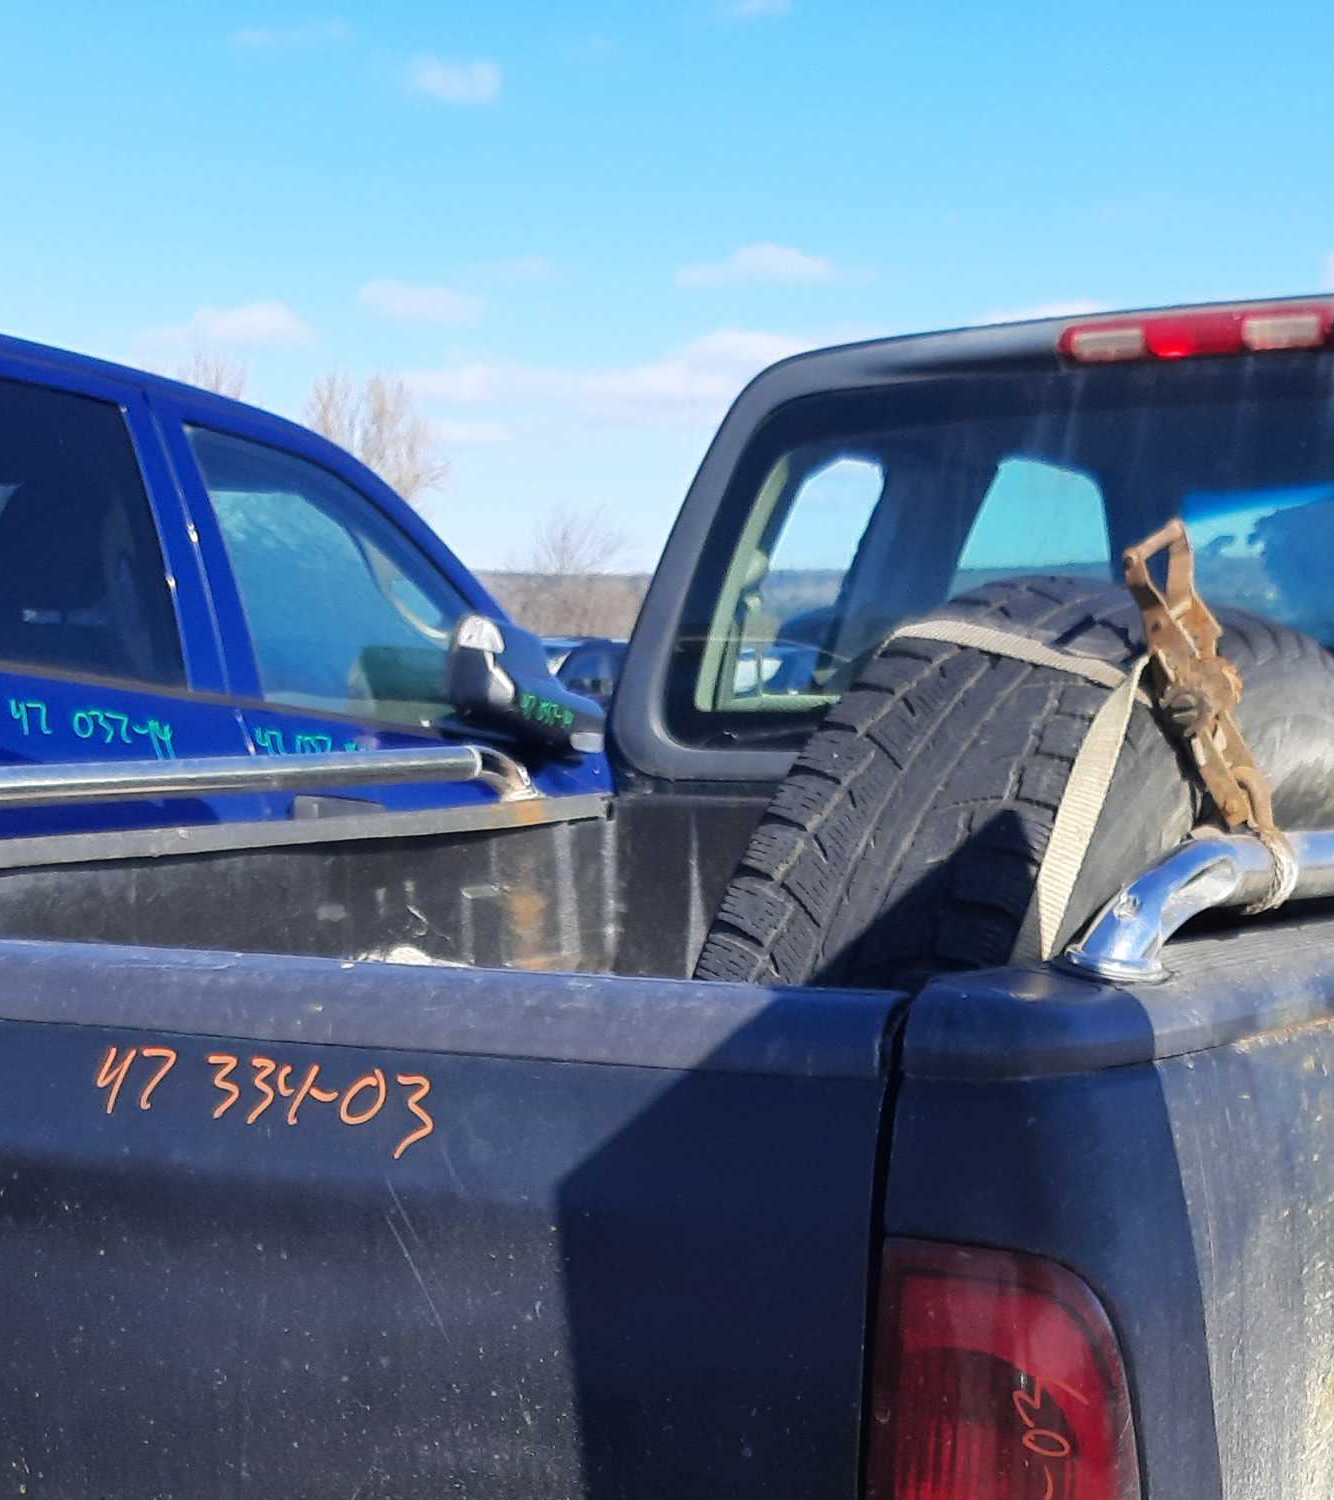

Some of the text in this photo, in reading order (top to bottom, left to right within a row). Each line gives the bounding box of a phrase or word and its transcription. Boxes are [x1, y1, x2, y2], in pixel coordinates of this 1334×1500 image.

[10, 698, 53, 736] 47
[95, 1047, 435, 1160] 47 334-03
